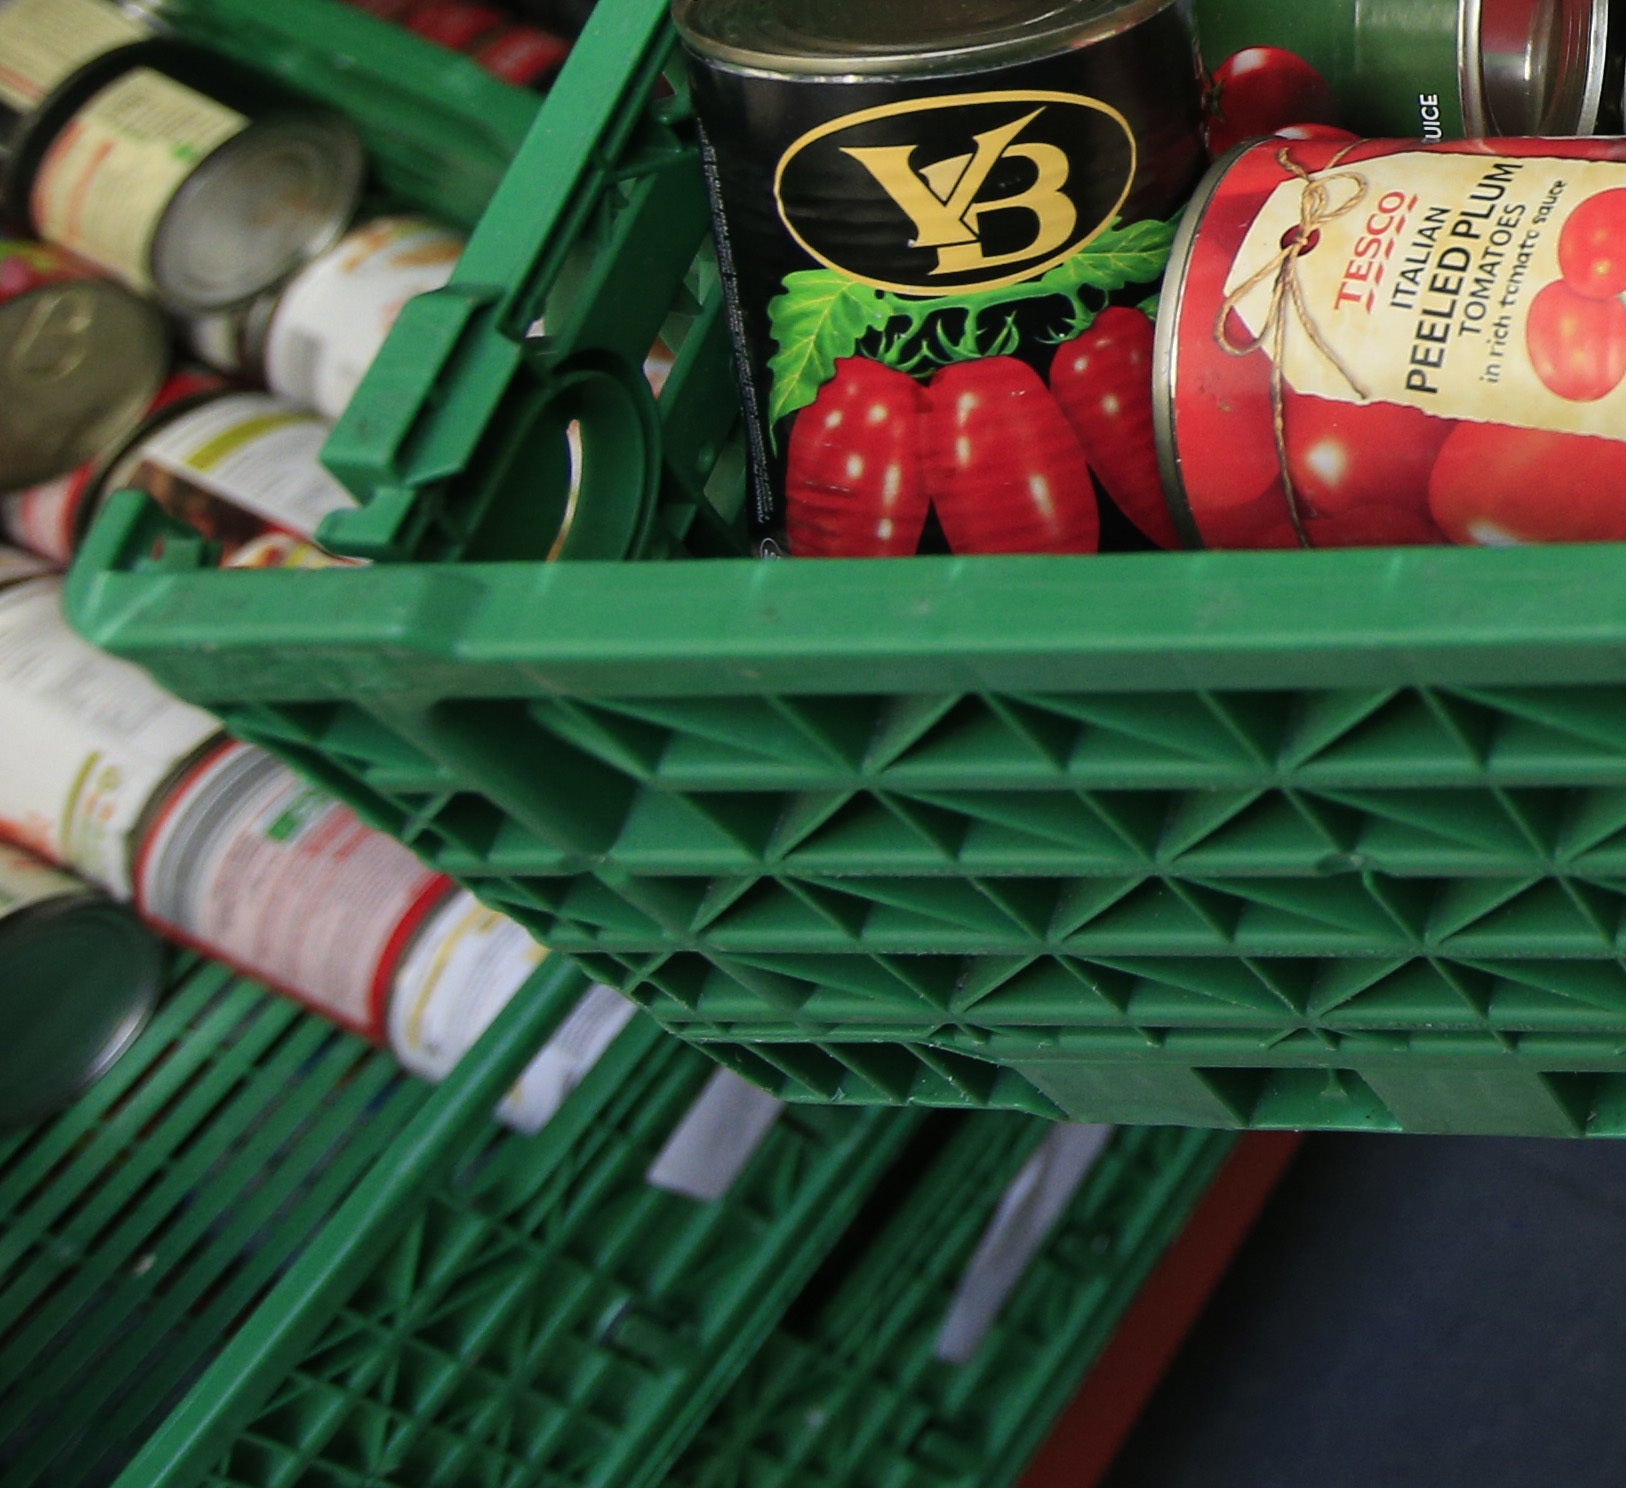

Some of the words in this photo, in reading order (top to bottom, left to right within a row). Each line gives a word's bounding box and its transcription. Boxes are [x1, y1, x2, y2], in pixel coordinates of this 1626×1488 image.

[1419, 94, 1442, 141] UICE
[1531, 177, 1566, 222] sauce
[1334, 191, 1406, 311] TESCO
[1389, 206, 1451, 310] ITALIAN
[1404, 247, 1471, 394] PEELED
[1449, 160, 1523, 240] PLUM
[1458, 204, 1526, 337] TOMATOES
[1499, 227, 1540, 308] tomato
[1479, 365, 1502, 381] in
[1486, 314, 1511, 357] rich
